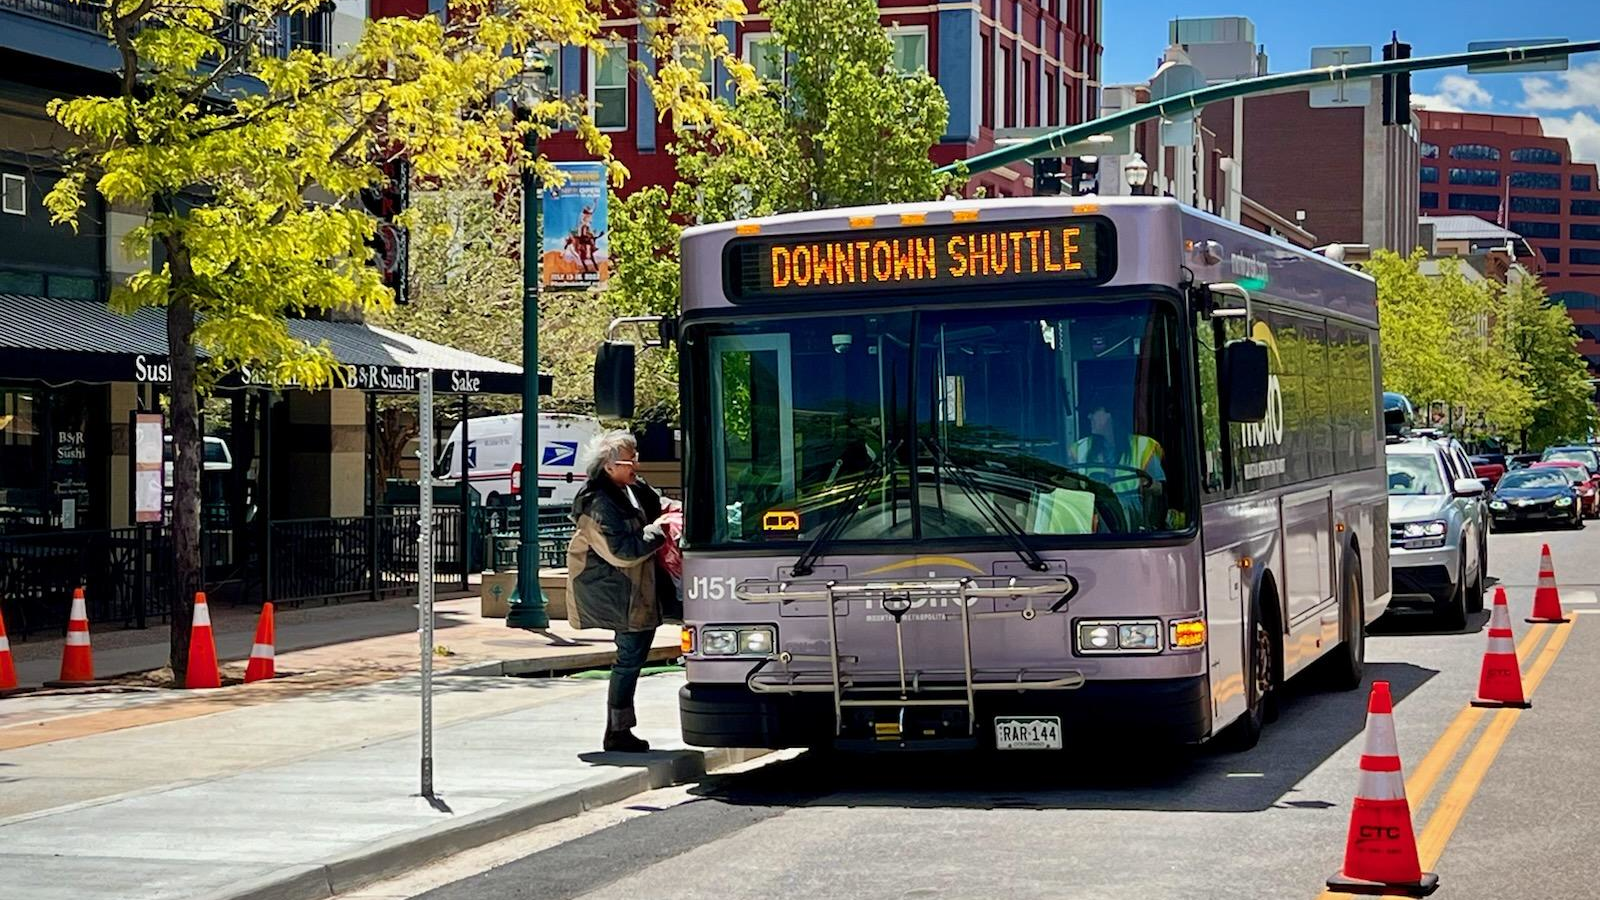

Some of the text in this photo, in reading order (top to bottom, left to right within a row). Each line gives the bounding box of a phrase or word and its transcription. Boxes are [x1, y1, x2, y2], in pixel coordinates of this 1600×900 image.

[771, 227, 1082, 288] DOWNTOWN SHUTTLE
[380, 366, 415, 390] Sushi
[451, 370, 480, 392] Sake
[57, 446, 86, 459] Sushi
[687, 576, 737, 600] J151
